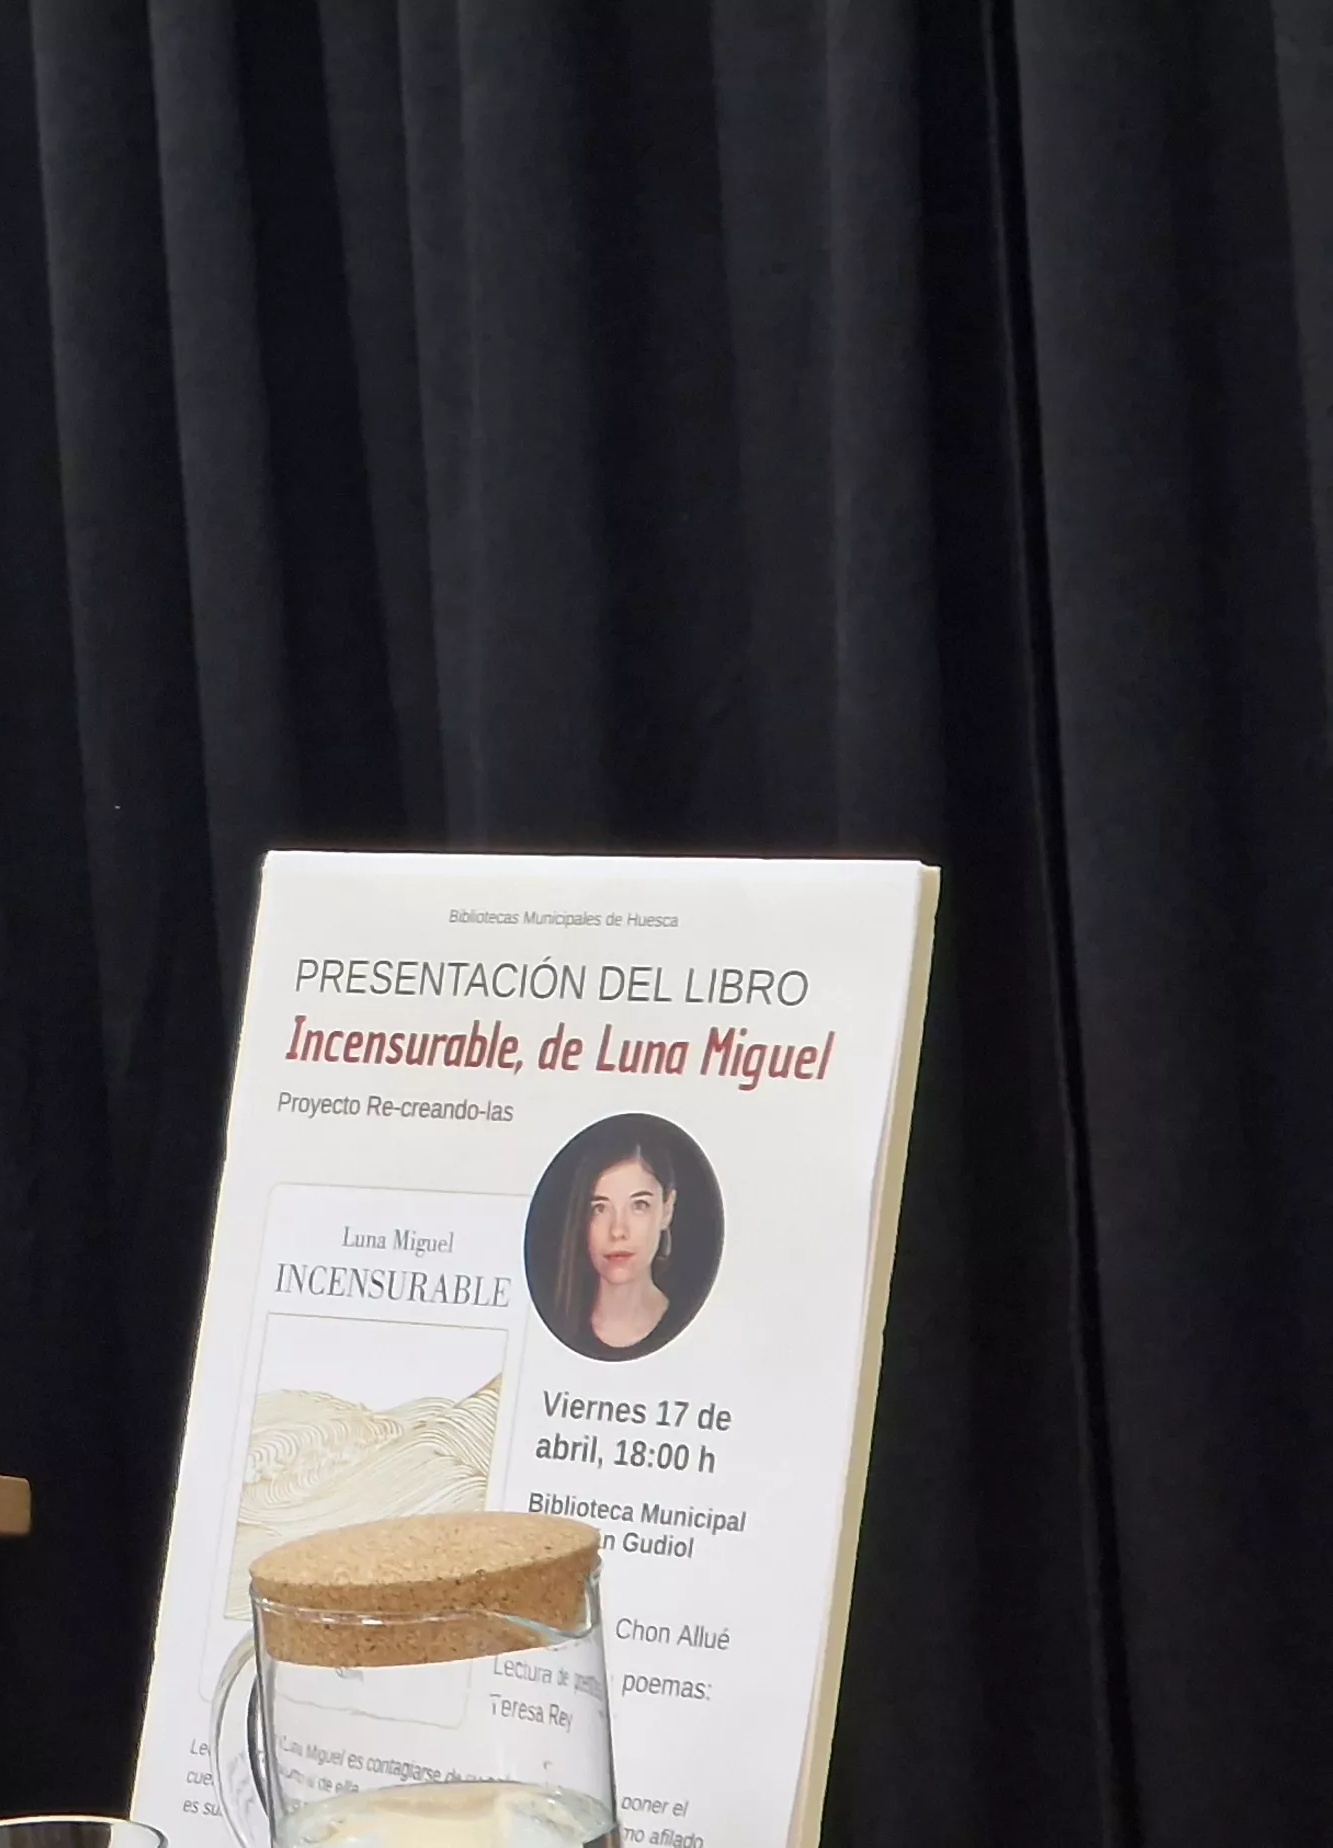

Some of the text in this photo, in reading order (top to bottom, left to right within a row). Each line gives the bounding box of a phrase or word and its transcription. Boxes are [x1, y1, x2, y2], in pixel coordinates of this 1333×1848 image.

[449, 909, 679, 929] Bibliotecas Municipales de Huesca
[294, 955, 810, 1007] PRESENTACIÓN DEL LIBRO
[284, 1014, 837, 1092] Incensurable, de Luna Miguel
[276, 1091, 515, 1123] Proyecto Re-creando-las
[341, 1226, 455, 1258] Luna Miguel
[275, 1262, 513, 1308] INCENSURABLE
[542, 1389, 732, 1432] Viernes 17 de
[535, 1432, 716, 1474] abril, 18:00 h
[527, 1491, 747, 1536] Biblioteca Municipal
[621, 1531, 695, 1559] Gudiol
[615, 1617, 731, 1651] Chon Allué
[493, 1655, 553, 1685] Lectura
[621, 1673, 713, 1701] poemas:
[489, 1692, 574, 1734] Teresa Rey
[185, 1769, 214, 1787] cue
[347, 1752, 364, 1770] es
[366, 1756, 442, 1783] contagiarse
[672, 1800, 690, 1818] el
[182, 1799, 224, 1818] es su
